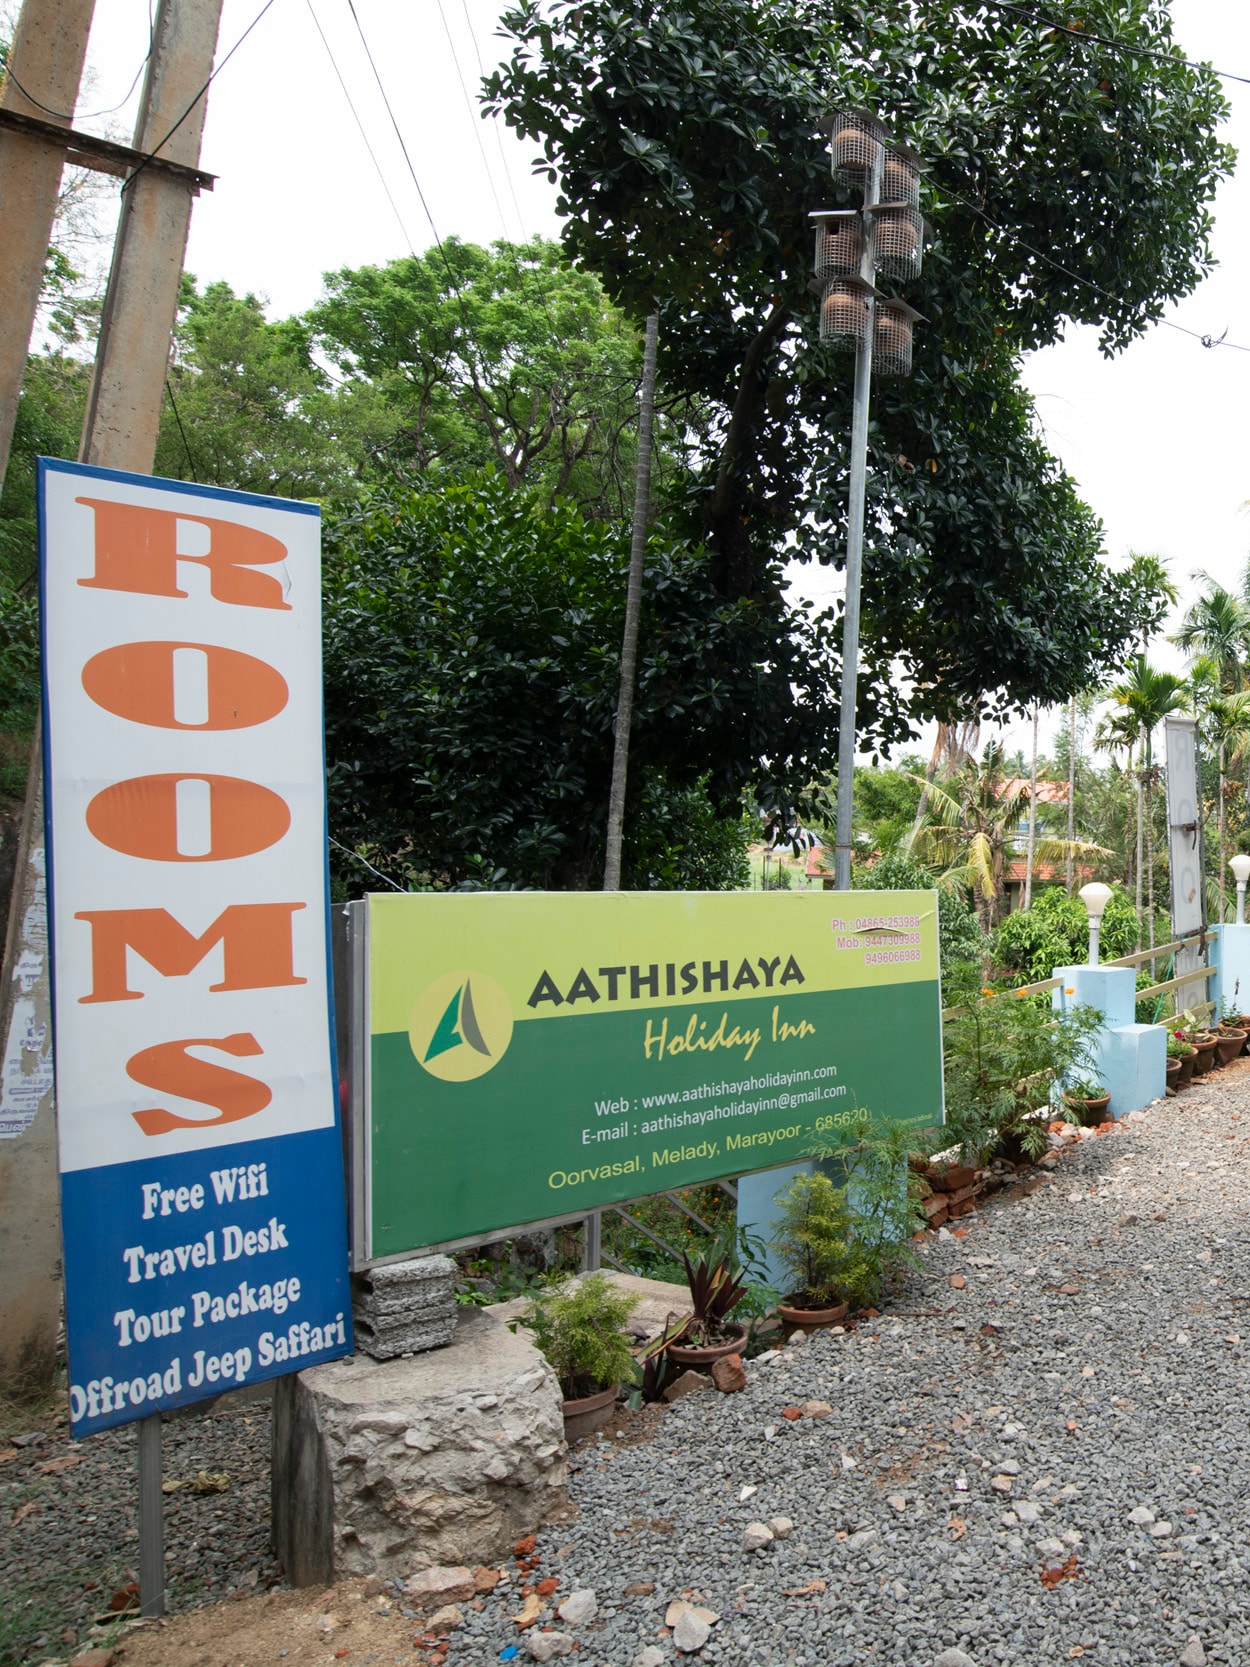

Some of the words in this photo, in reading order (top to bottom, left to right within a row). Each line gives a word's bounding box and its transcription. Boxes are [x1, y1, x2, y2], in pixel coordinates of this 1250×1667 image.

[832, 918, 846, 931] Ph
[855, 916, 920, 929] 04865-253988
[837, 936, 862, 949] Mob:
[865, 932, 920, 947] 9447309988
[526, 954, 806, 1010] AATHISHAYA
[866, 949, 921, 965] 9496066988
[643, 1012, 761, 1062] Holiday
[771, 1004, 818, 1044] Inn
[582, 1120, 630, 1147] E-mail
[641, 1084, 847, 1135] aathishayaholidayinn@gmail.com
[595, 1094, 631, 1118] Web
[641, 1064, 838, 1109] www.aathishayaholidayinn.com
[548, 1153, 647, 1190] Oorvasal,
[652, 1140, 721, 1170] Melady,
[725, 1121, 802, 1157] Marayoor
[815, 1107, 868, 1132] 685620
[142, 1181, 205, 1221] Free
[210, 1162, 270, 1206] Wifi
[123, 1230, 217, 1284] Travel
[222, 1216, 289, 1262] Desk
[114, 1303, 186, 1348] Tour
[191, 1276, 301, 1328] Package
[70, 1357, 183, 1424] Offroad
[188, 1346, 252, 1388] Jeep
[258, 1312, 346, 1368] Saffari
